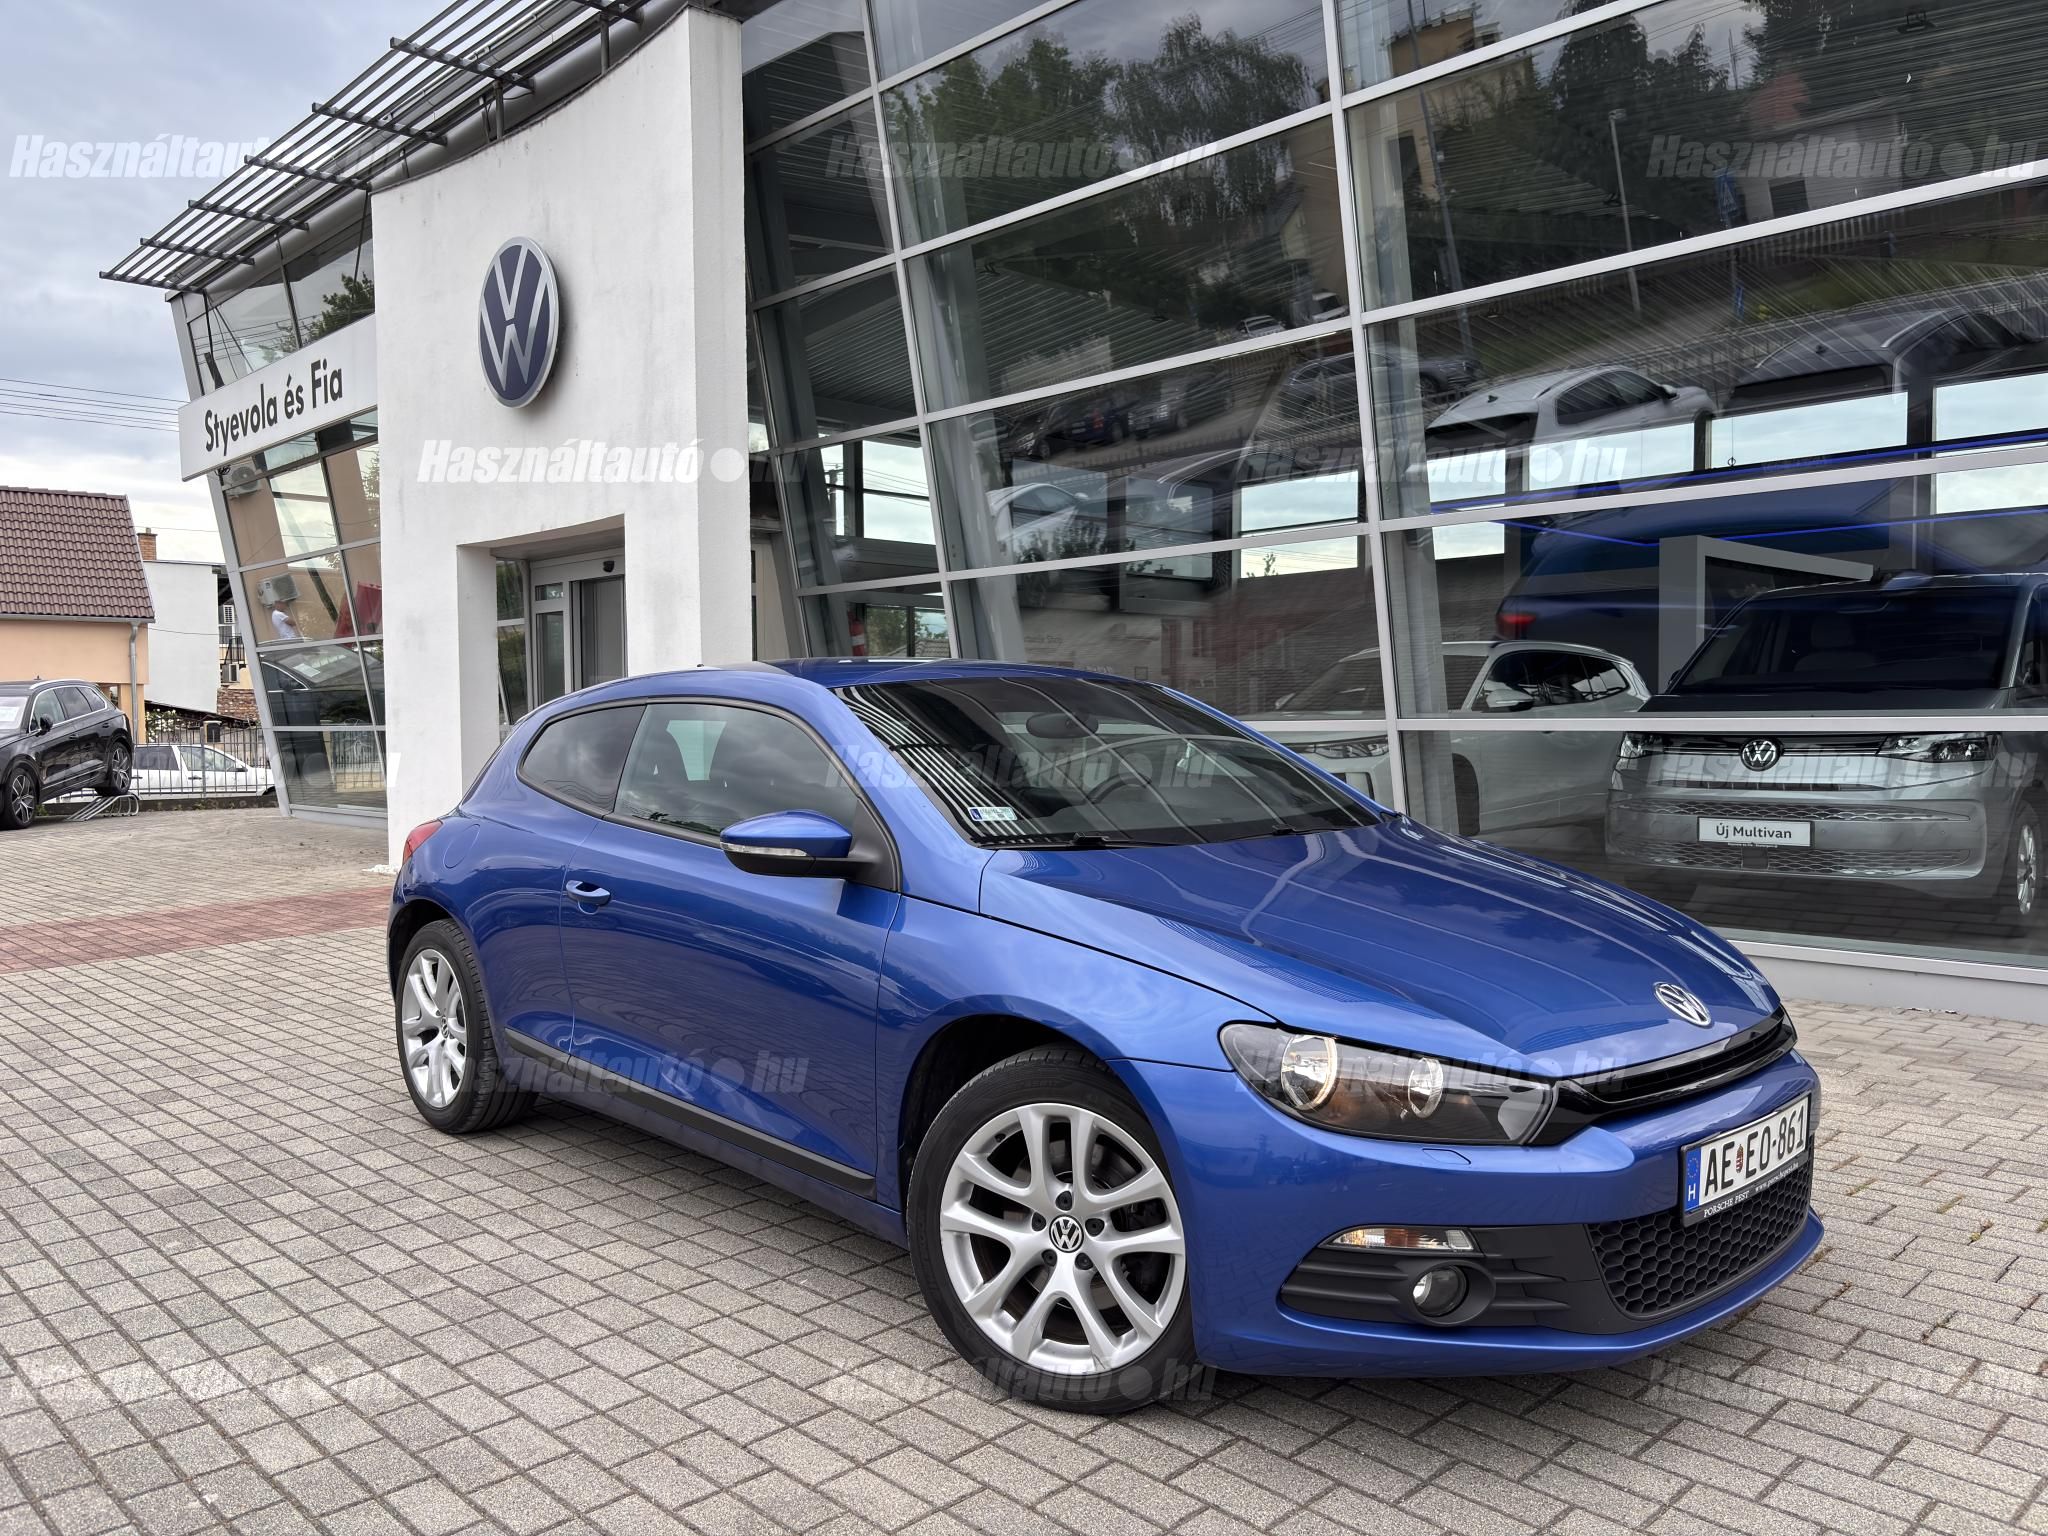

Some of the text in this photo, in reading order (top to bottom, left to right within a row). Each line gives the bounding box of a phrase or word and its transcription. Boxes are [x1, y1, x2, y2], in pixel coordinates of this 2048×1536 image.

[204, 358, 343, 457] Styevola és Fia
[1716, 822, 1792, 839] Új Multivan
[1704, 1140, 1735, 1197] AE
[1687, 1182, 1697, 1202] H
[1703, 1197, 1734, 1218] PORSCHE
[1735, 1190, 1750, 1204] PEST
